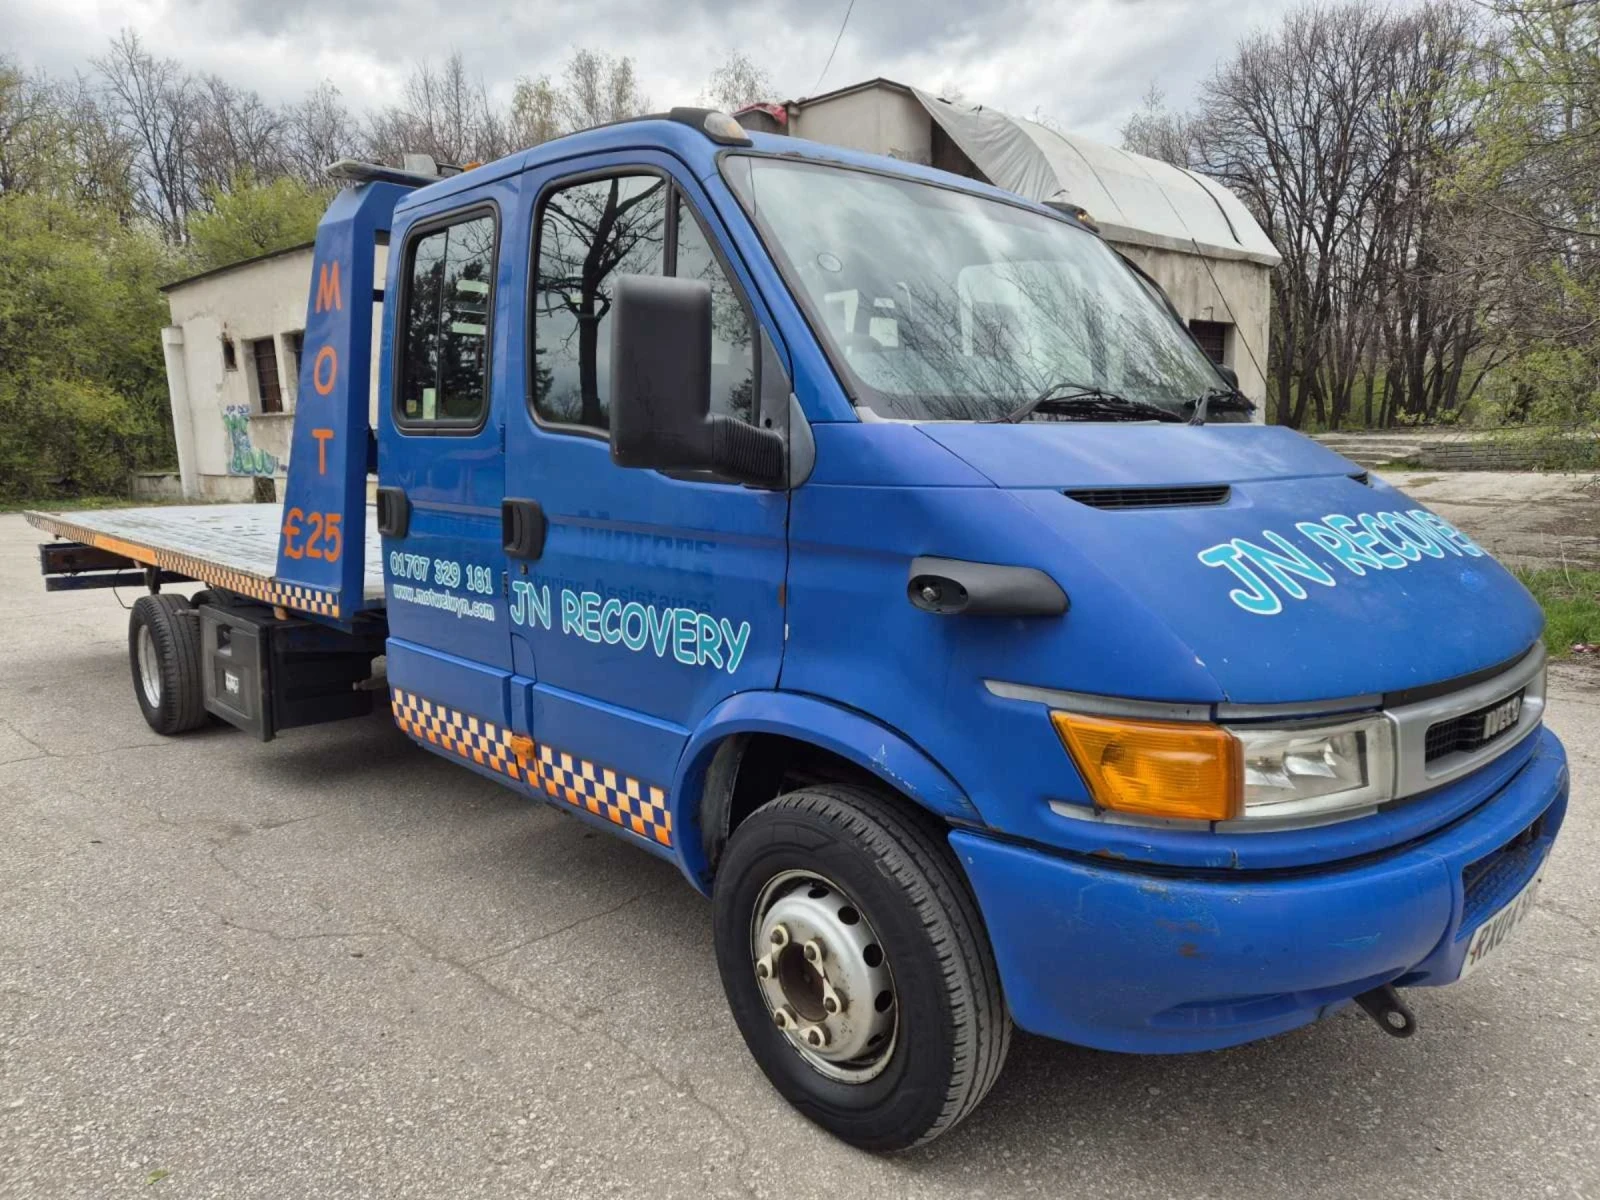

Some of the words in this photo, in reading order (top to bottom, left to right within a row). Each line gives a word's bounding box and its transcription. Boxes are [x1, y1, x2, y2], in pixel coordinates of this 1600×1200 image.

[281, 507, 343, 563] £25
[1197, 530, 1336, 615] JN
[1295, 509, 1490, 576] RECOVE
[389, 551, 430, 582] 01707
[433, 558, 461, 588] 329
[465, 564, 493, 595] 181
[393, 583, 495, 622] www.motwelwyn.com
[510, 580, 551, 630] JN
[561, 589, 750, 674] RECOVERY
